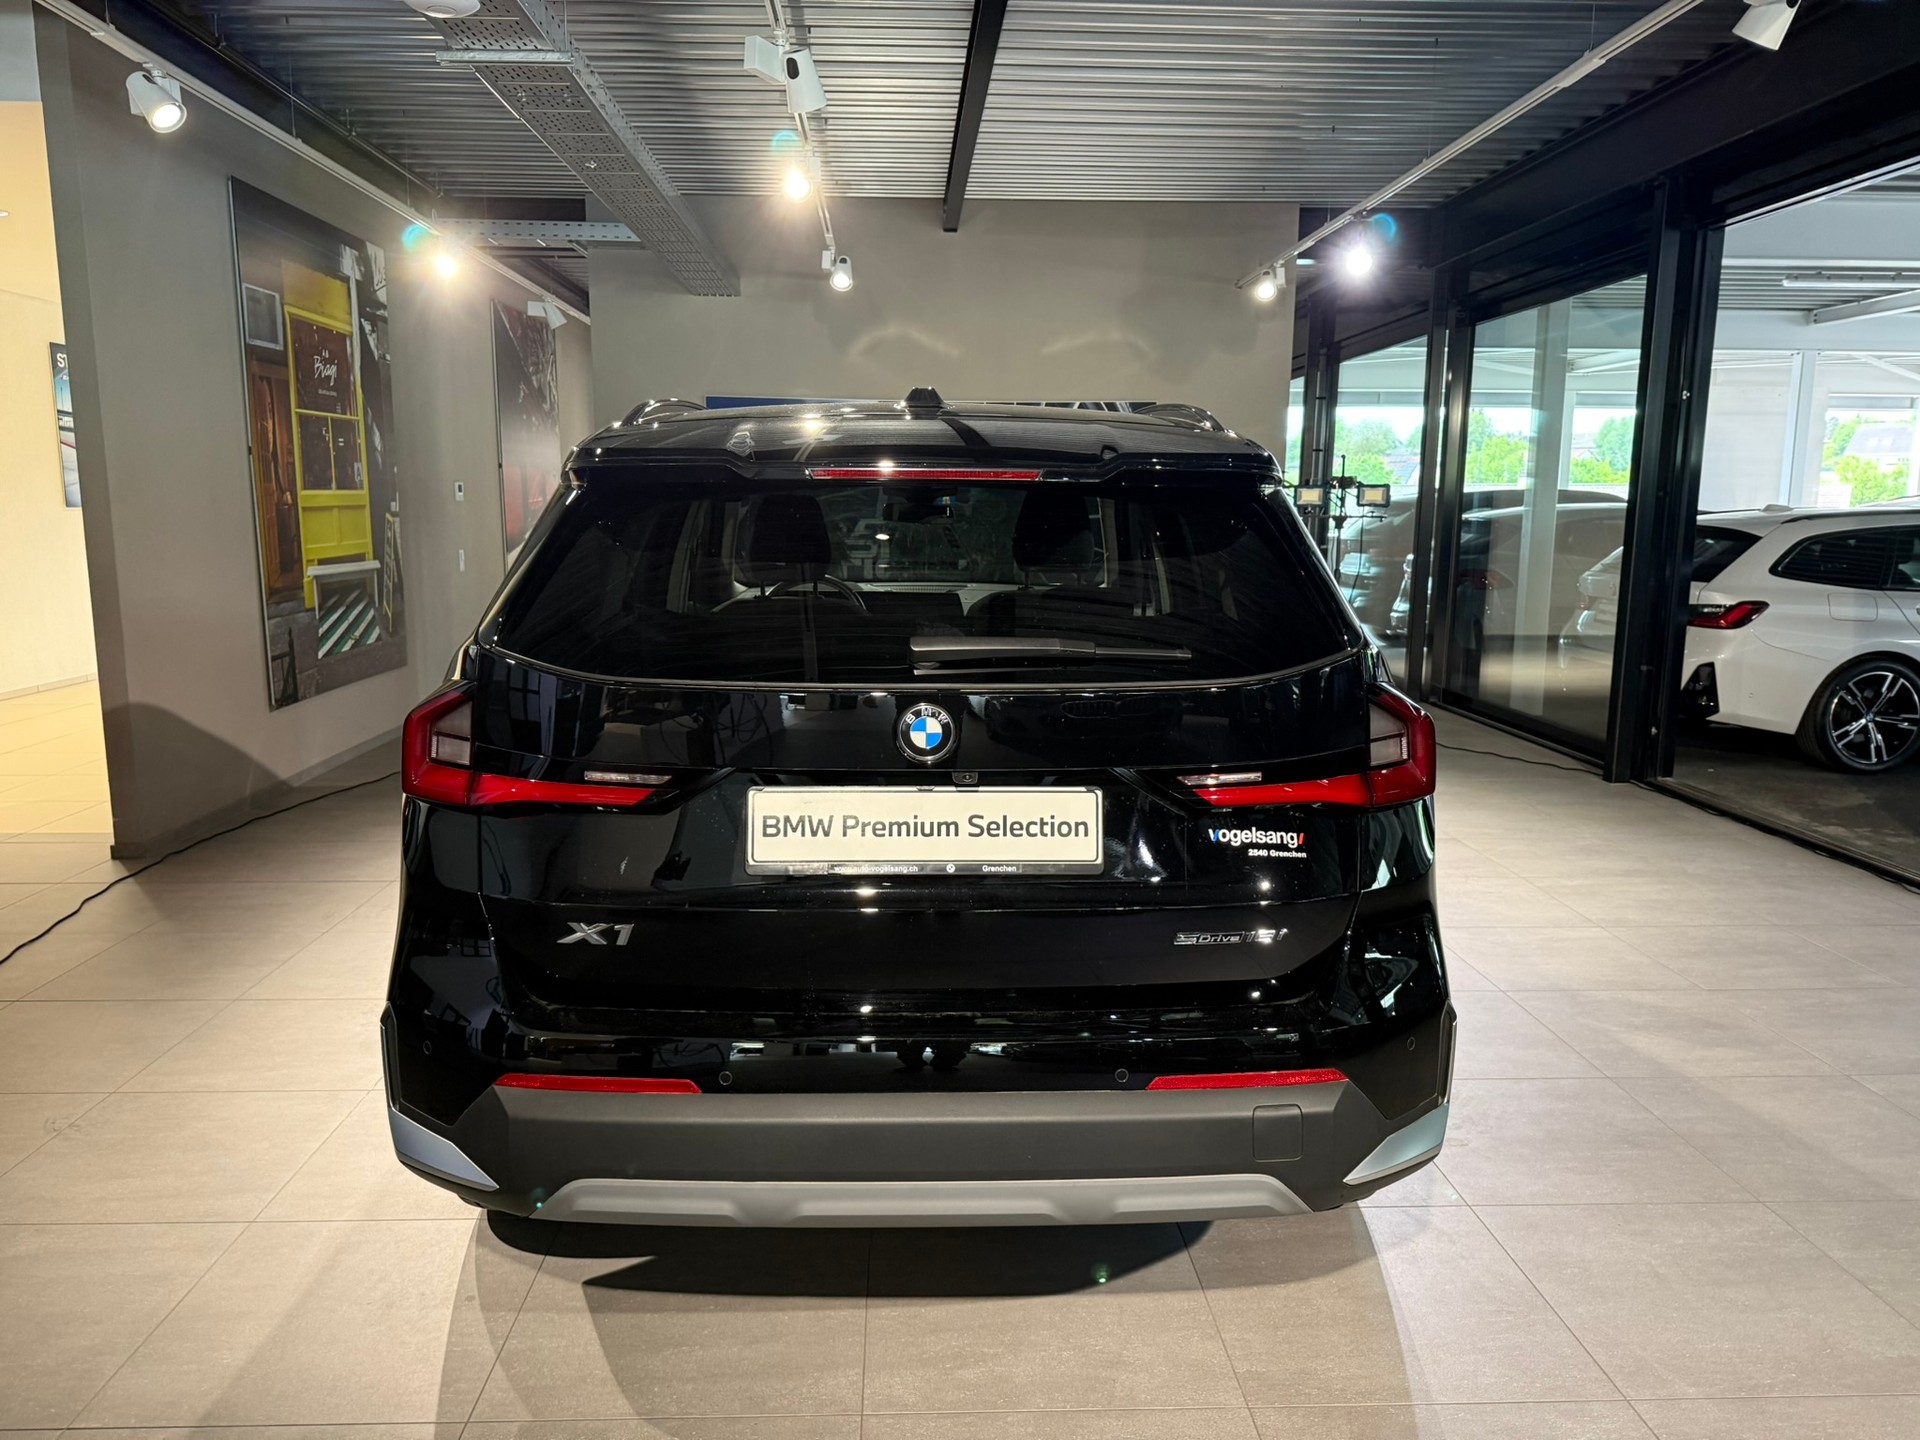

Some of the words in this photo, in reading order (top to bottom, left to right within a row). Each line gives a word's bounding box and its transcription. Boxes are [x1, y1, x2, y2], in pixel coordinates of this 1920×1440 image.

[905, 706, 949, 725] BMW
[761, 814, 834, 838] BMW
[842, 814, 960, 838] Premium
[967, 814, 1090, 838] Selection
[1247, 849, 1269, 857] 2540
[1269, 849, 1307, 859] Grenchen
[981, 864, 1018, 873] Grenchen
[556, 921, 635, 946] X1
